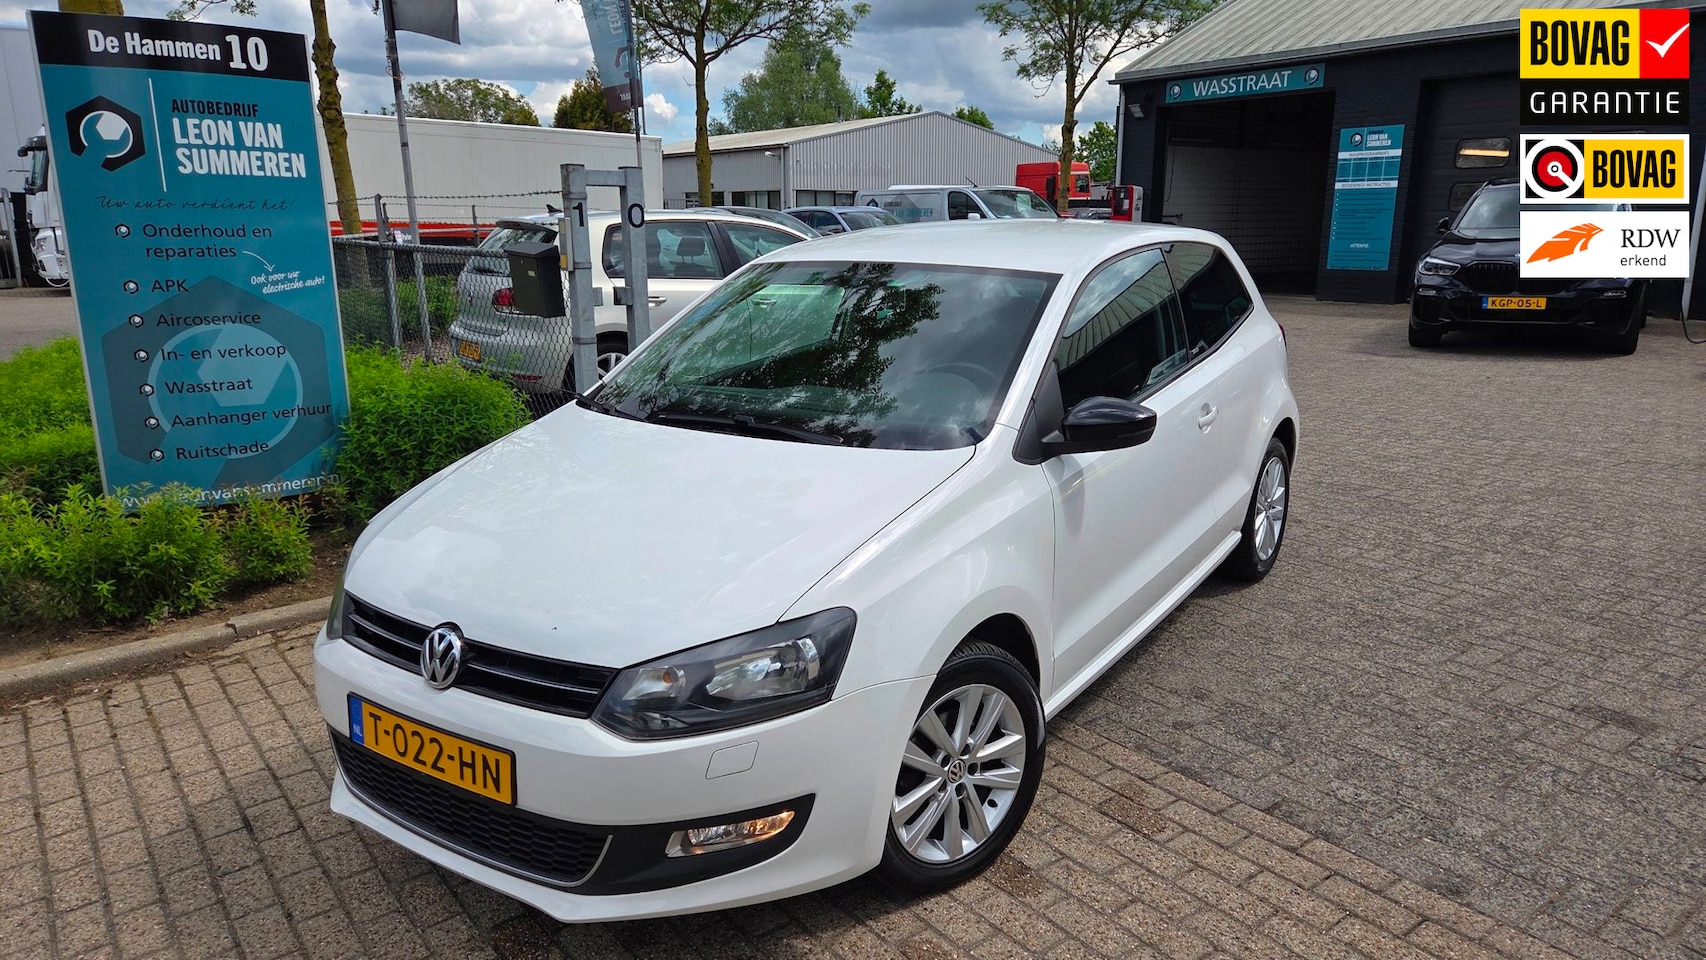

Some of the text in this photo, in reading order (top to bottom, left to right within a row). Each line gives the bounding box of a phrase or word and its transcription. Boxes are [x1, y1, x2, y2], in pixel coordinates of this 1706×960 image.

[87, 29, 269, 72] De Hammen 10
[1192, 70, 1293, 98] WASSTRAAT
[172, 98, 259, 118] AUTOBEDRIJF
[172, 117, 284, 149] LEON VAN
[176, 148, 307, 179] SUMMEREN
[96, 195, 295, 210] Uw auto verdient het!
[142, 223, 273, 239] Onderhoud en
[146, 244, 237, 261] reparaties
[151, 279, 190, 293] APK
[250, 271, 301, 285] Ook voor uw
[262, 275, 326, 294] electrische auto!
[1491, 298, 1542, 308] KGP-05-L
[156, 312, 262, 327] Aircoservice
[161, 343, 287, 361] In- en verkoop
[164, 378, 254, 395] Wasstraat
[171, 403, 332, 428] Aanhanger verhuur
[175, 440, 270, 460] Ruitschade
[353, 723, 363, 737] NL
[368, 711, 501, 794] T-022-HN
